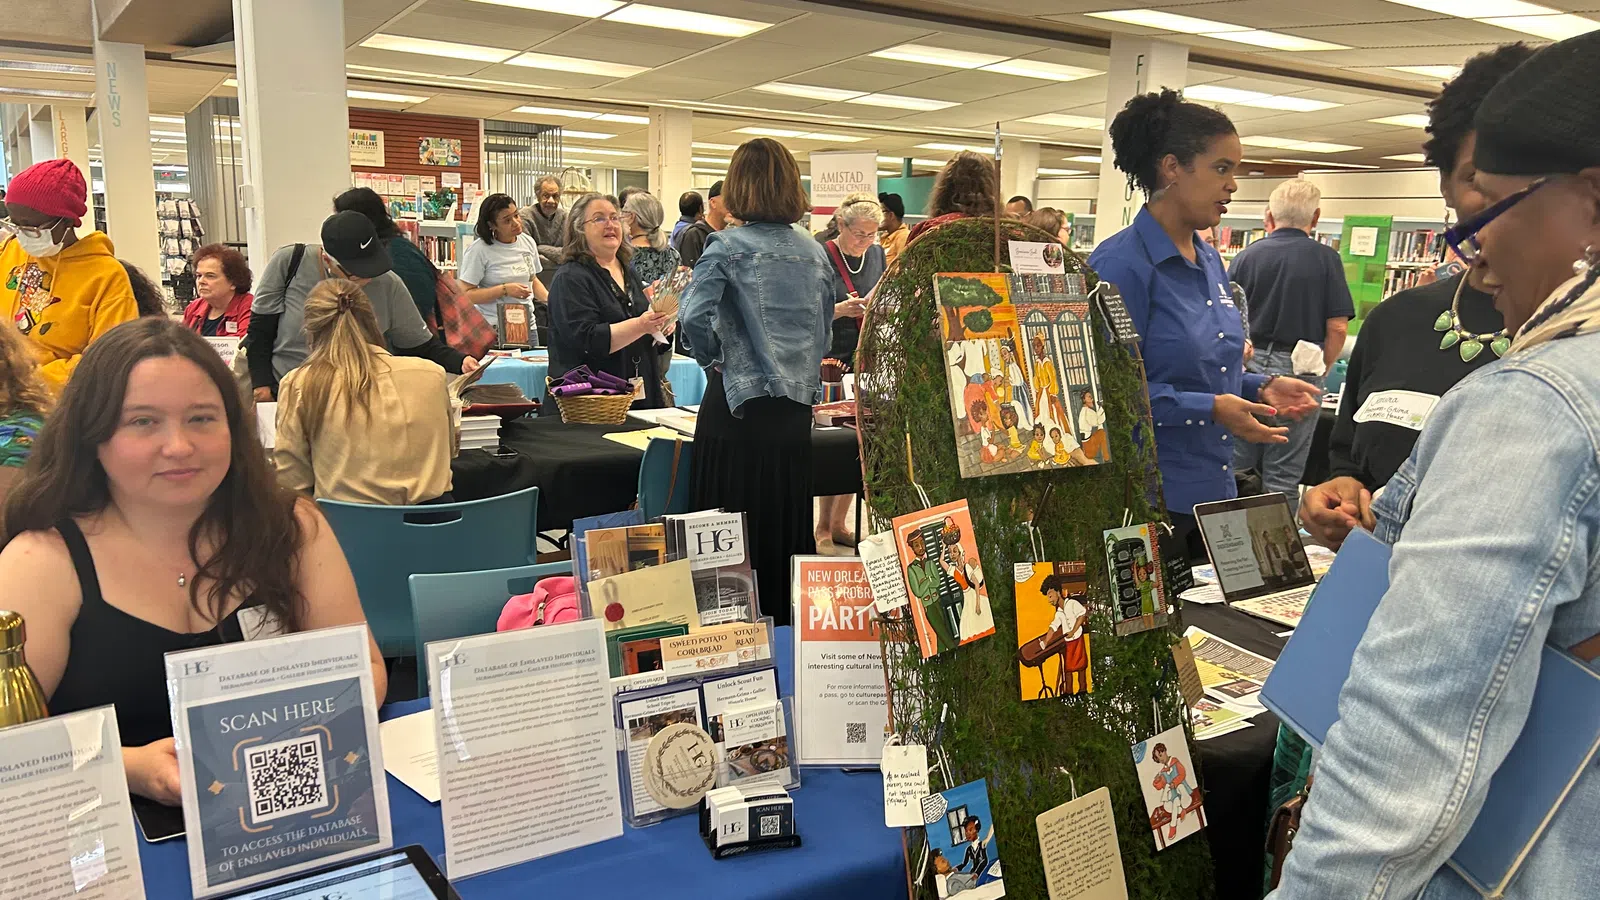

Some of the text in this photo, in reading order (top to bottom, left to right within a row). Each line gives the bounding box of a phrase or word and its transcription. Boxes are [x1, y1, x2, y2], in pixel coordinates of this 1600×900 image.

[106, 62, 120, 127] NEWS
[821, 172, 863, 183] AMISTAD
[813, 184, 872, 192] RESEARCH CENTER
[693, 527, 734, 554] HG
[807, 570, 870, 582] NEW ORLEA
[807, 586, 877, 598] PASS PROGR
[670, 634, 727, 649] (SWEET) POTATO
[184, 659, 210, 676] HG
[218, 670, 257, 682] DATABASE
[271, 662, 309, 672] ENSLAVED
[311, 654, 357, 665] INDIVIDUALS
[474, 663, 507, 673] DATABASE
[519, 656, 553, 666] ENSLAVED
[554, 649, 595, 659] INDIVIDUALS
[220, 677, 274, 690] HERMANN-GRIMA
[280, 671, 305, 679] GALLIER
[306, 667, 332, 675] HISTORIC
[475, 670, 522, 680] HERMANN-GRIMA
[527, 664, 549, 672] GALLIER
[716, 680, 736, 689] Unlock
[716, 692, 749, 701] Hermann-Grima
[220, 697, 334, 733] SCAN HERE
[729, 717, 743, 728] HG
[1, 771, 33, 782] GALLIER
[35, 762, 69, 774] HISTORIC
[900, 769, 920, 778] enslaved
[913, 778, 925, 786] could
[899, 788, 916, 799] legally
[221, 814, 361, 856] TO ACCESS THE DATABASE
[723, 821, 742, 836] HG
[218, 827, 367, 871] OF ENSLAVED INDIVIDUALS
